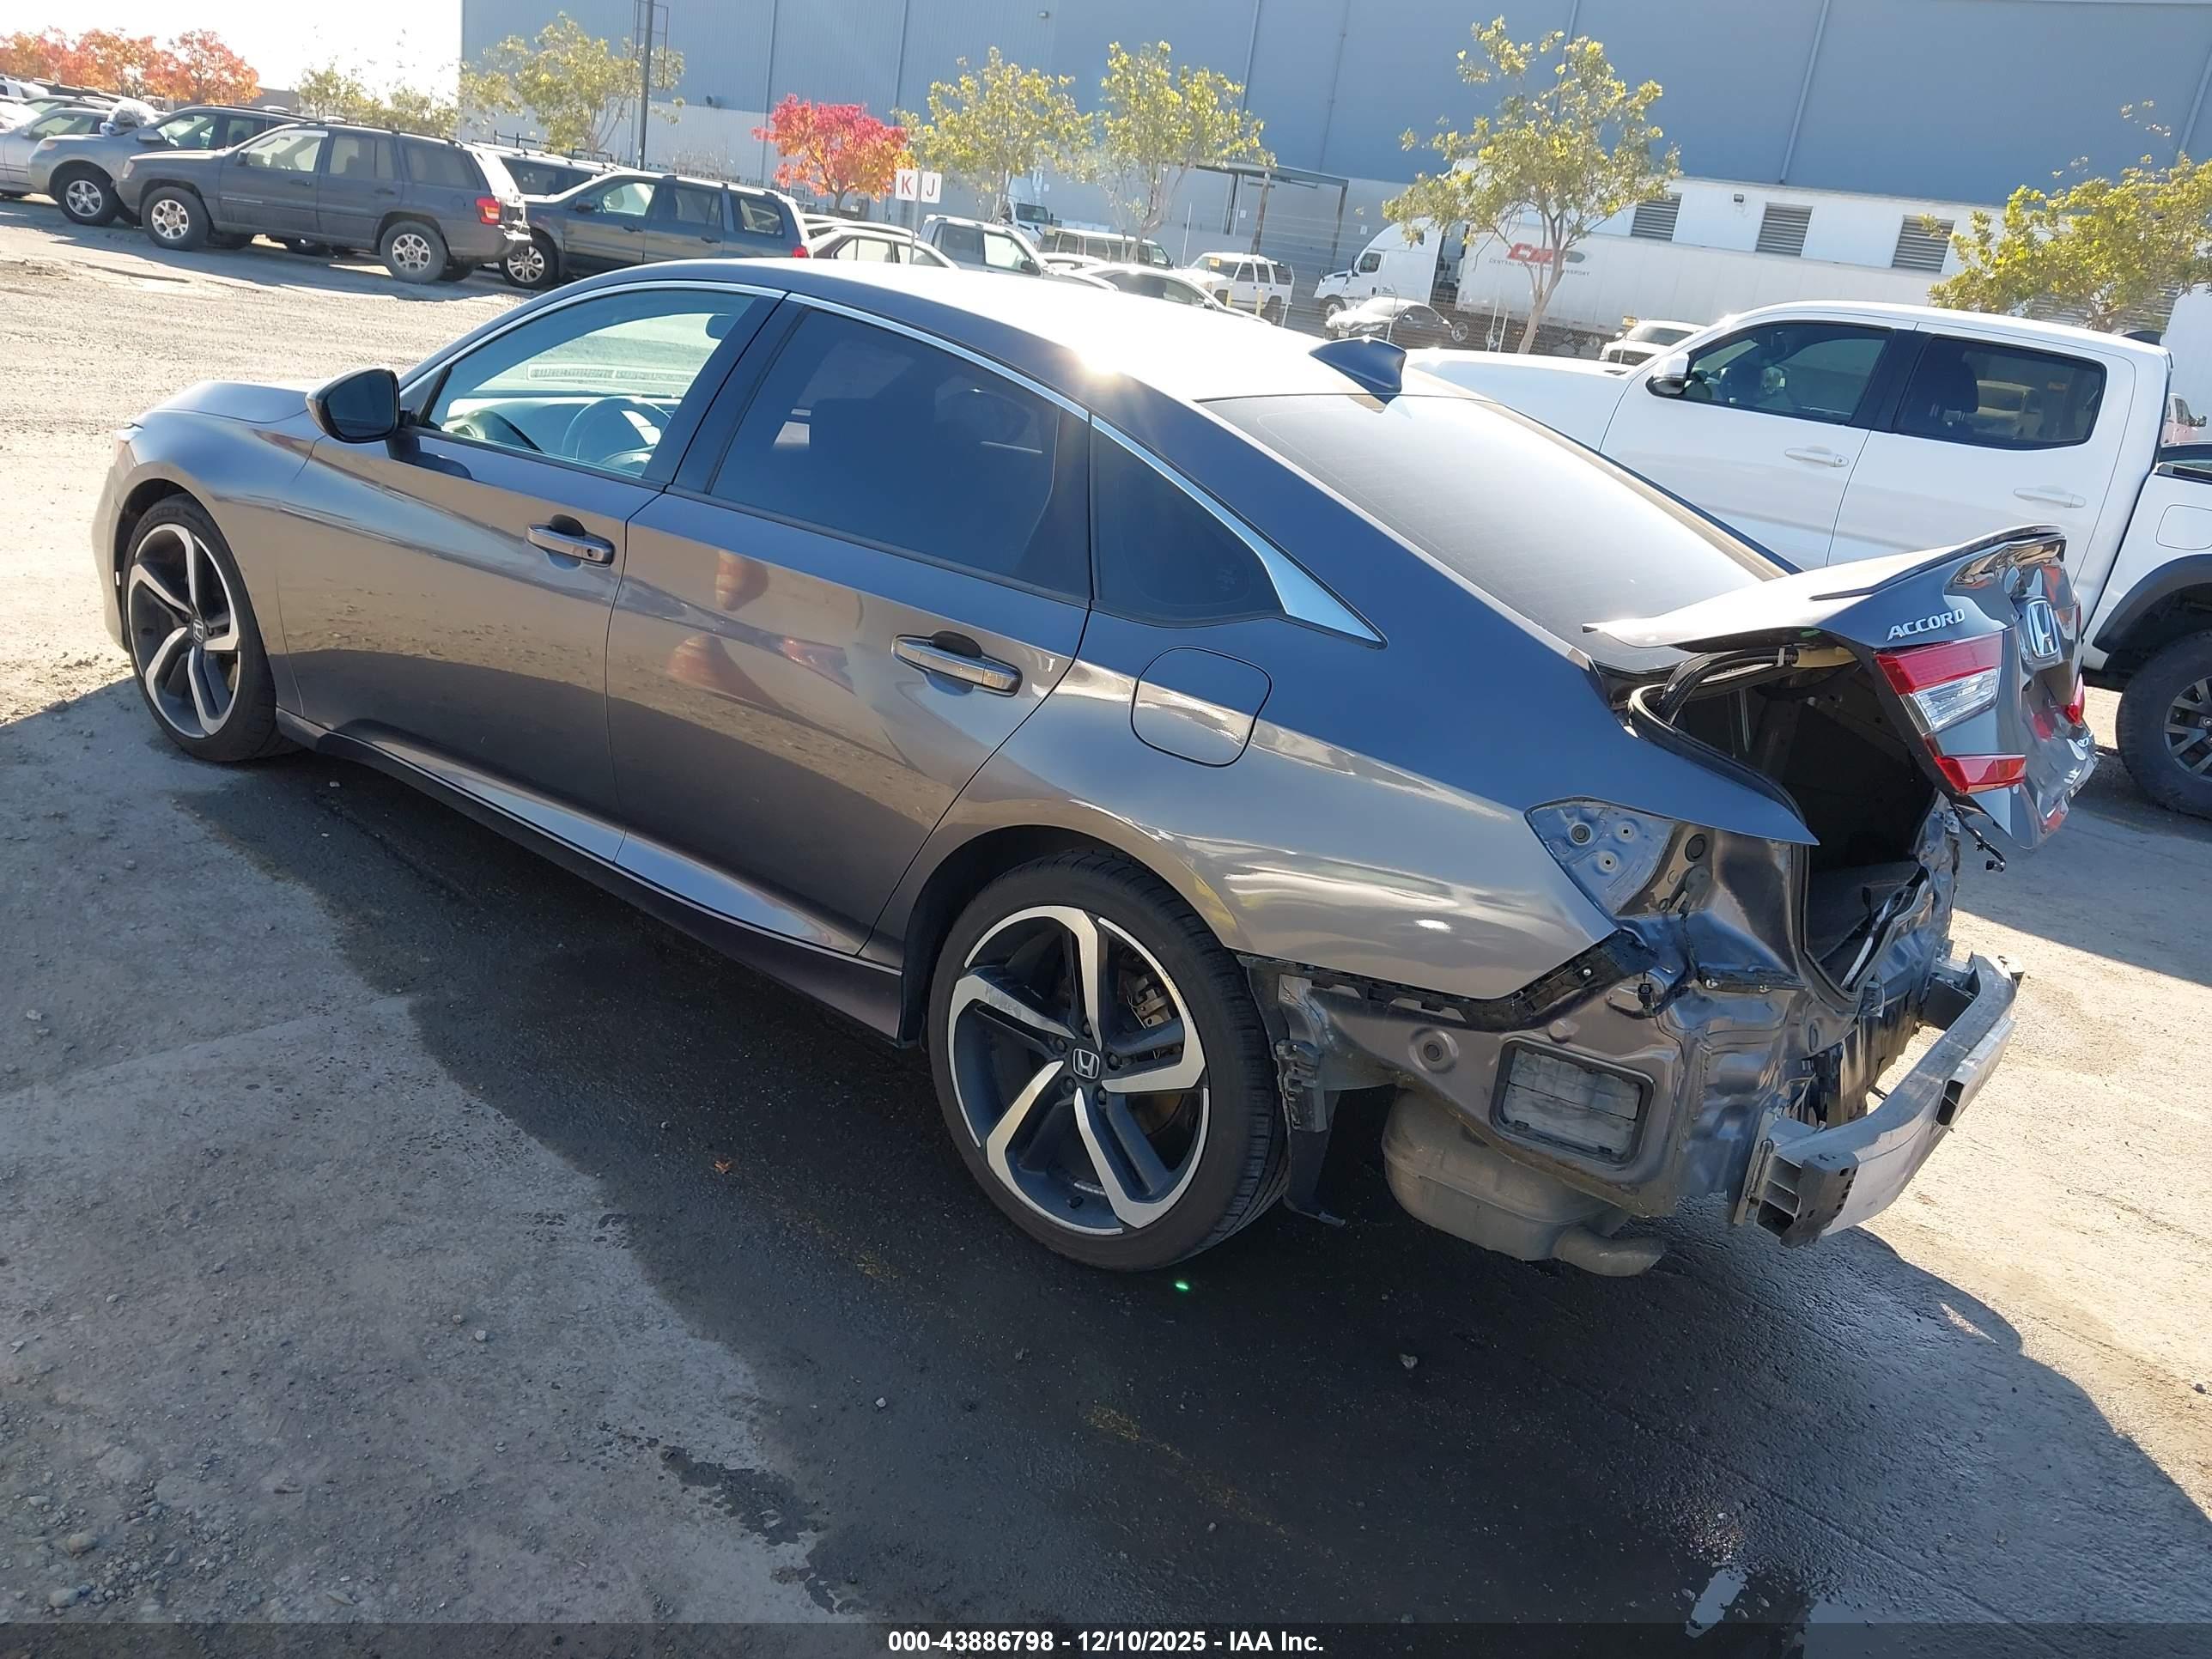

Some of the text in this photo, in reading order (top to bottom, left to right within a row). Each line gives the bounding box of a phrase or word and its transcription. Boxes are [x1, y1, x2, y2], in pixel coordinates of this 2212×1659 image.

[902, 175, 912, 195] K
[926, 178, 936, 197] J
[1887, 608, 1966, 641] ACCORD
